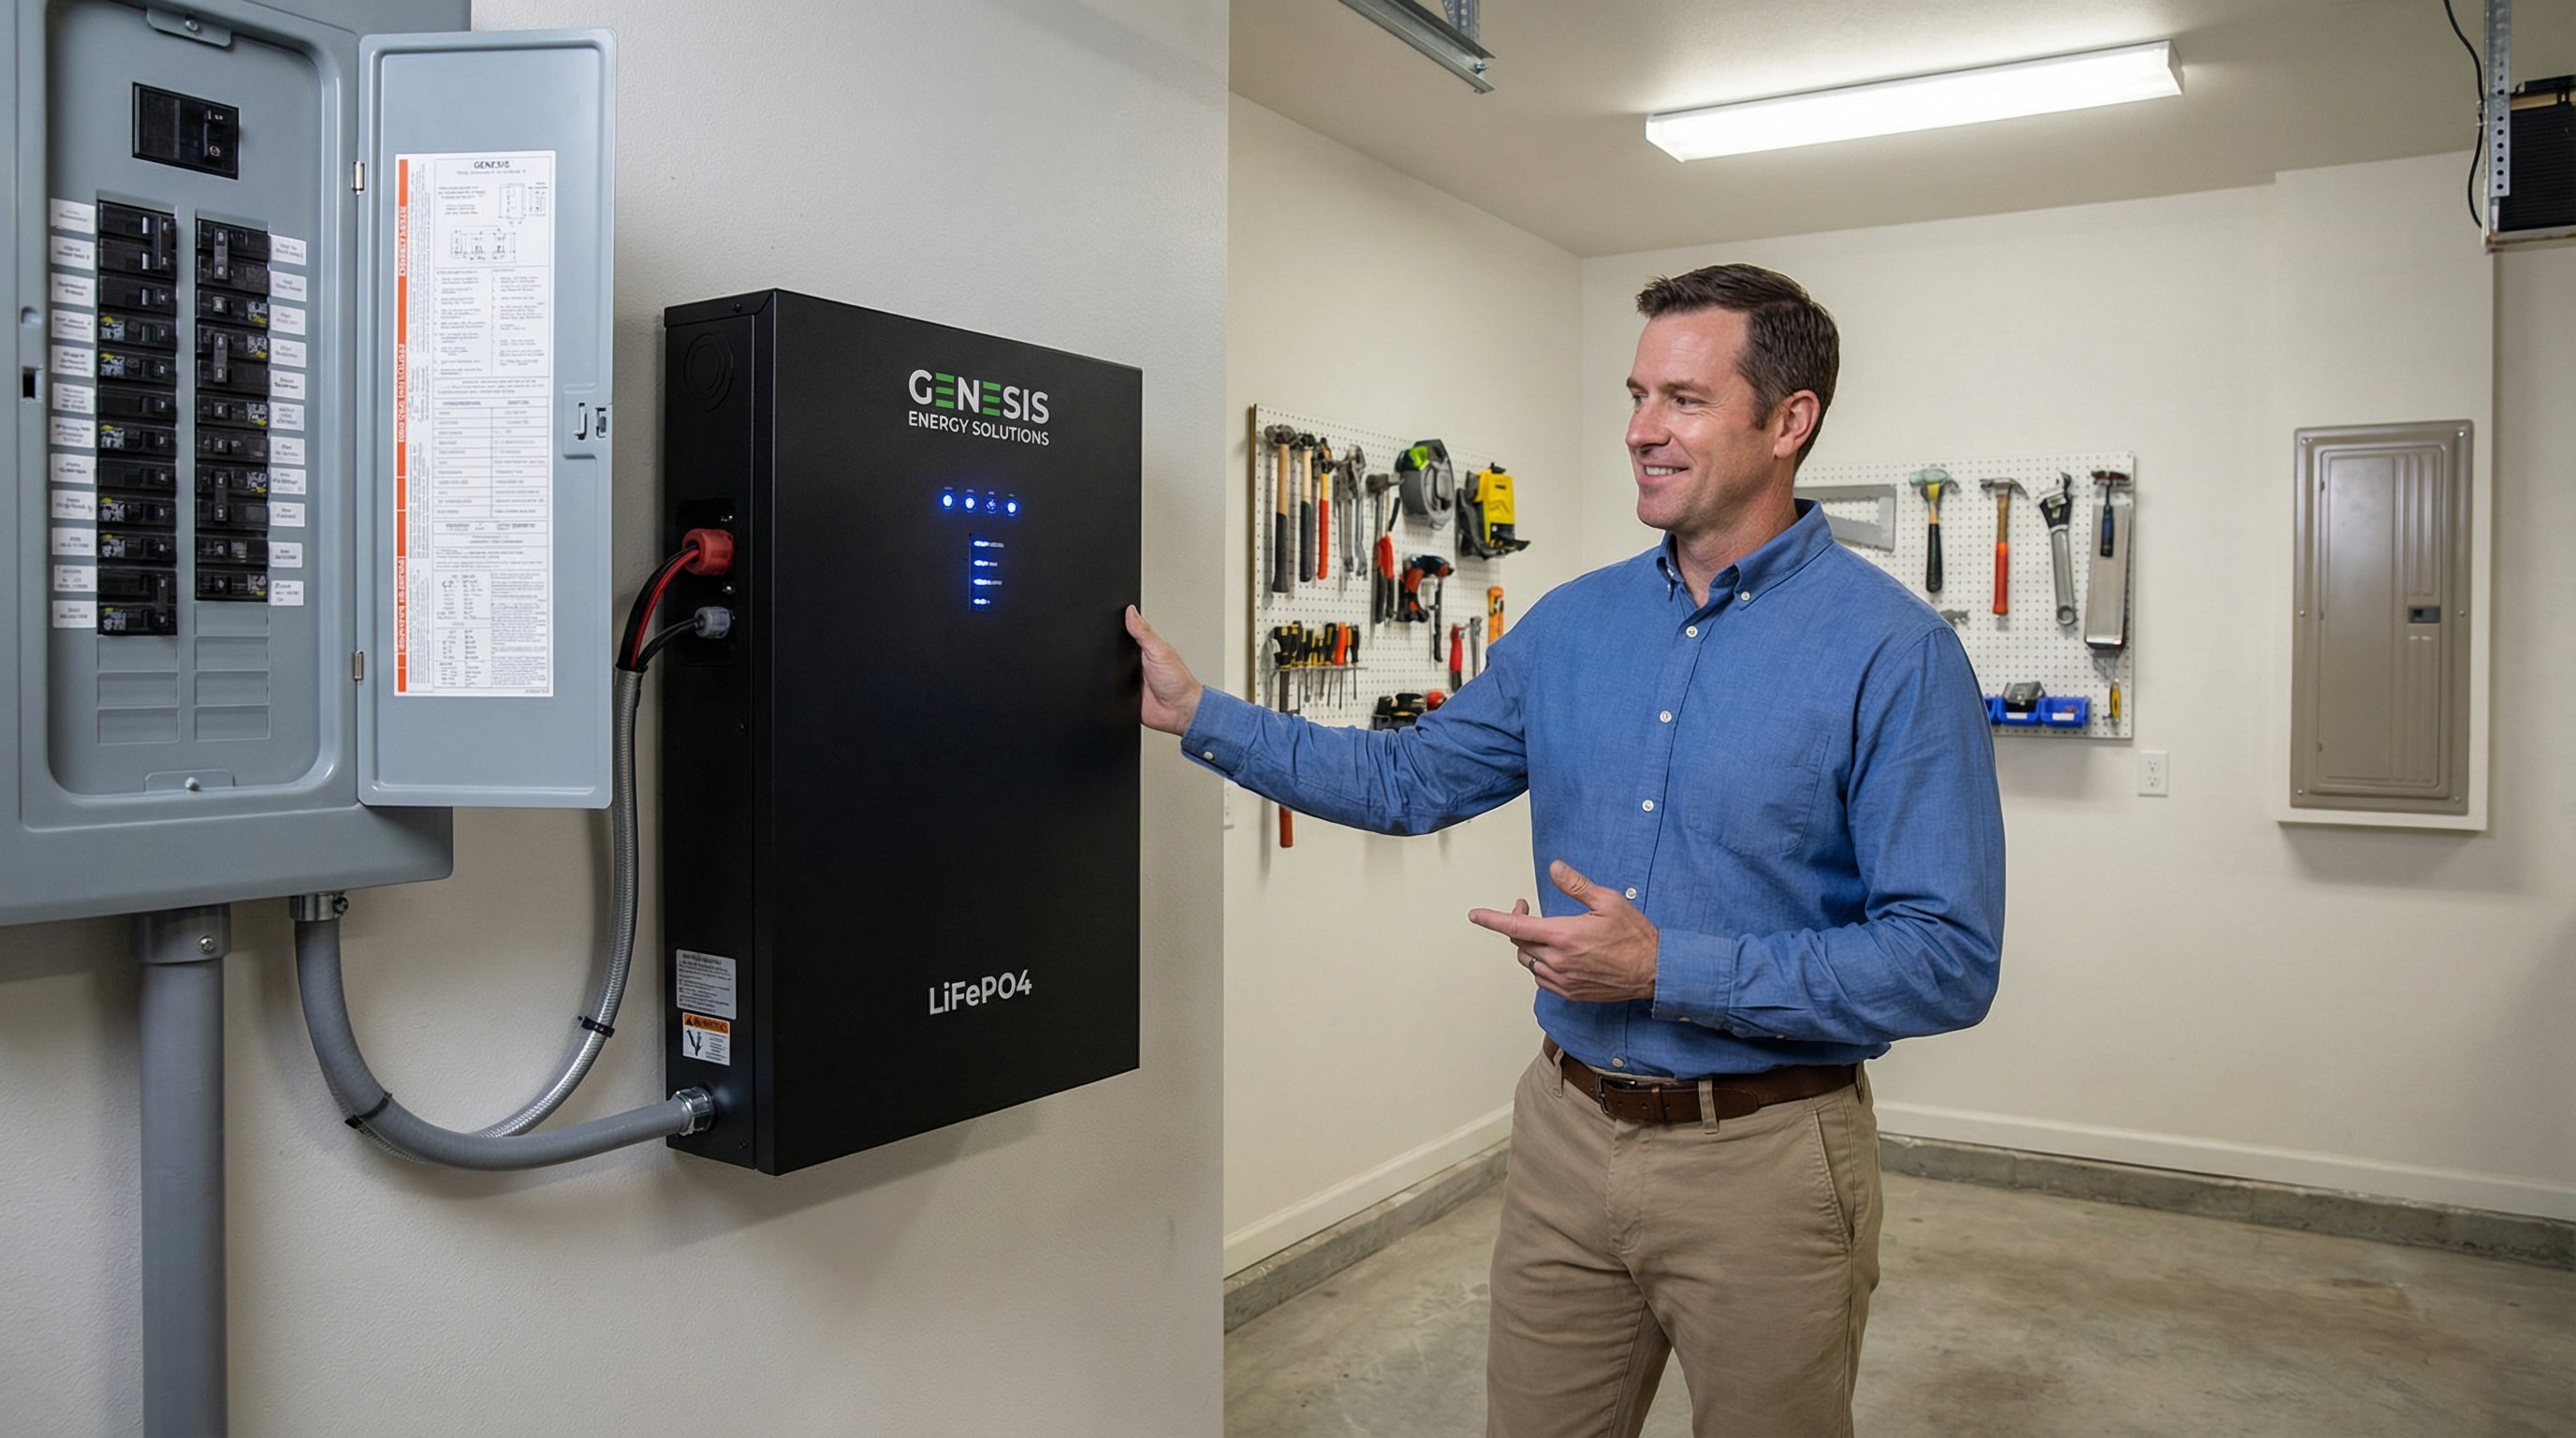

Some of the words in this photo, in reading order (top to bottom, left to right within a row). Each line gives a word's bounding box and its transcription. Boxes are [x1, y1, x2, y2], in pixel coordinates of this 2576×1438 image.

[908, 369, 1050, 425] GENESIS
[908, 410, 970, 433] ENERGY
[972, 420, 1050, 447] SOLUTIONS
[929, 969, 1032, 1016] LiFePO4
